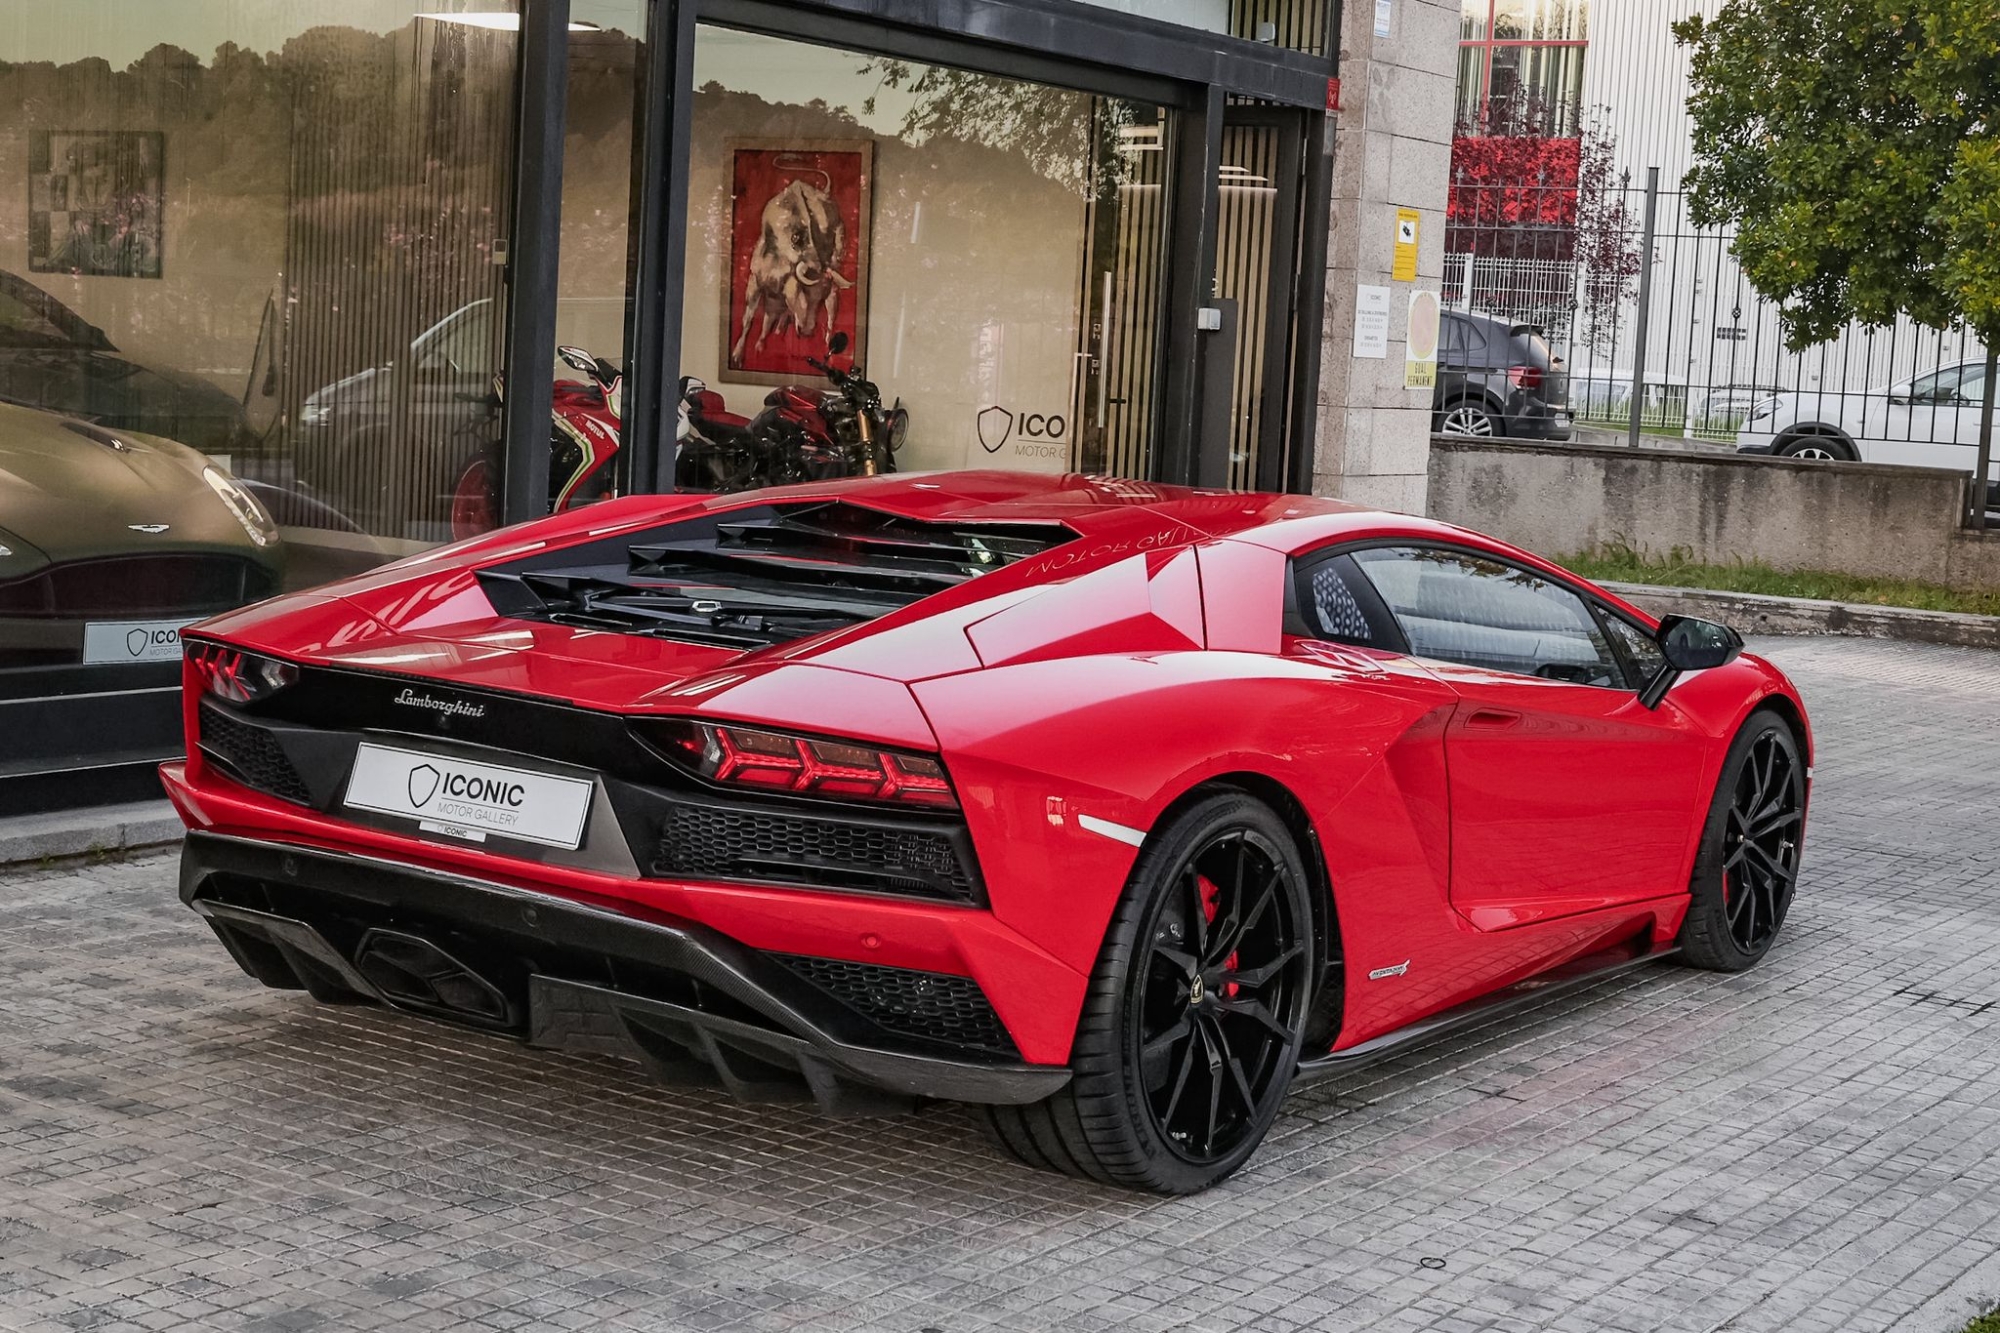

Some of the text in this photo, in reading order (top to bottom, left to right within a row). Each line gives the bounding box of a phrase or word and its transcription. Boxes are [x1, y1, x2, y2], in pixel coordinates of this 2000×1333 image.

[1018, 412, 1066, 439] ICO
[1015, 445, 1057, 458] MOTOR
[149, 647, 172, 656] MOTOR
[394, 688, 485, 717] Lamborghini
[442, 772, 525, 807] ICONIC
[437, 802, 519, 827] MOTOR GALLERY
[443, 826, 467, 837] ICONIC
